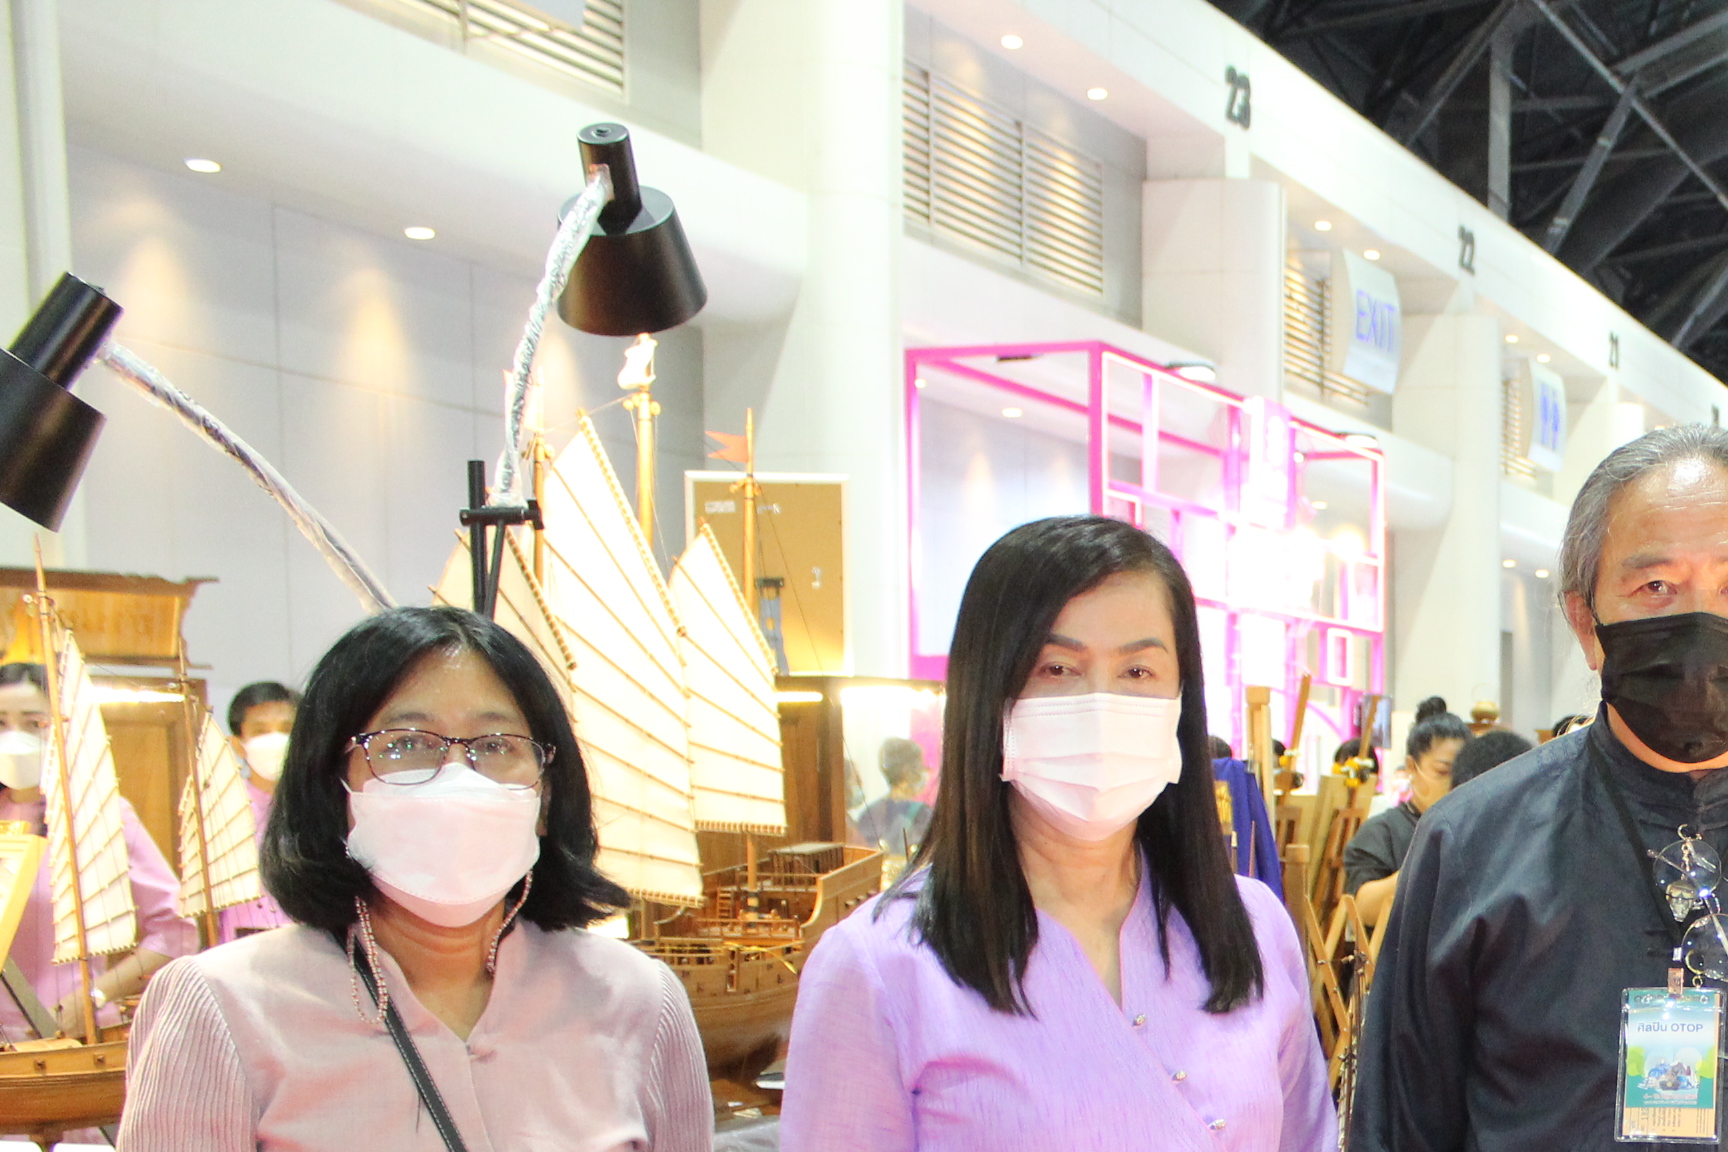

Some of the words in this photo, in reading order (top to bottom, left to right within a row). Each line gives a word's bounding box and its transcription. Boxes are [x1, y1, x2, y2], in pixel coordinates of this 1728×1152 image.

[1225, 66, 1251, 131] 23
[1356, 289, 1395, 352] EXIT
[1637, 1022, 1668, 1032] ศิลปิน
[1670, 1023, 1704, 1032] OTOP
